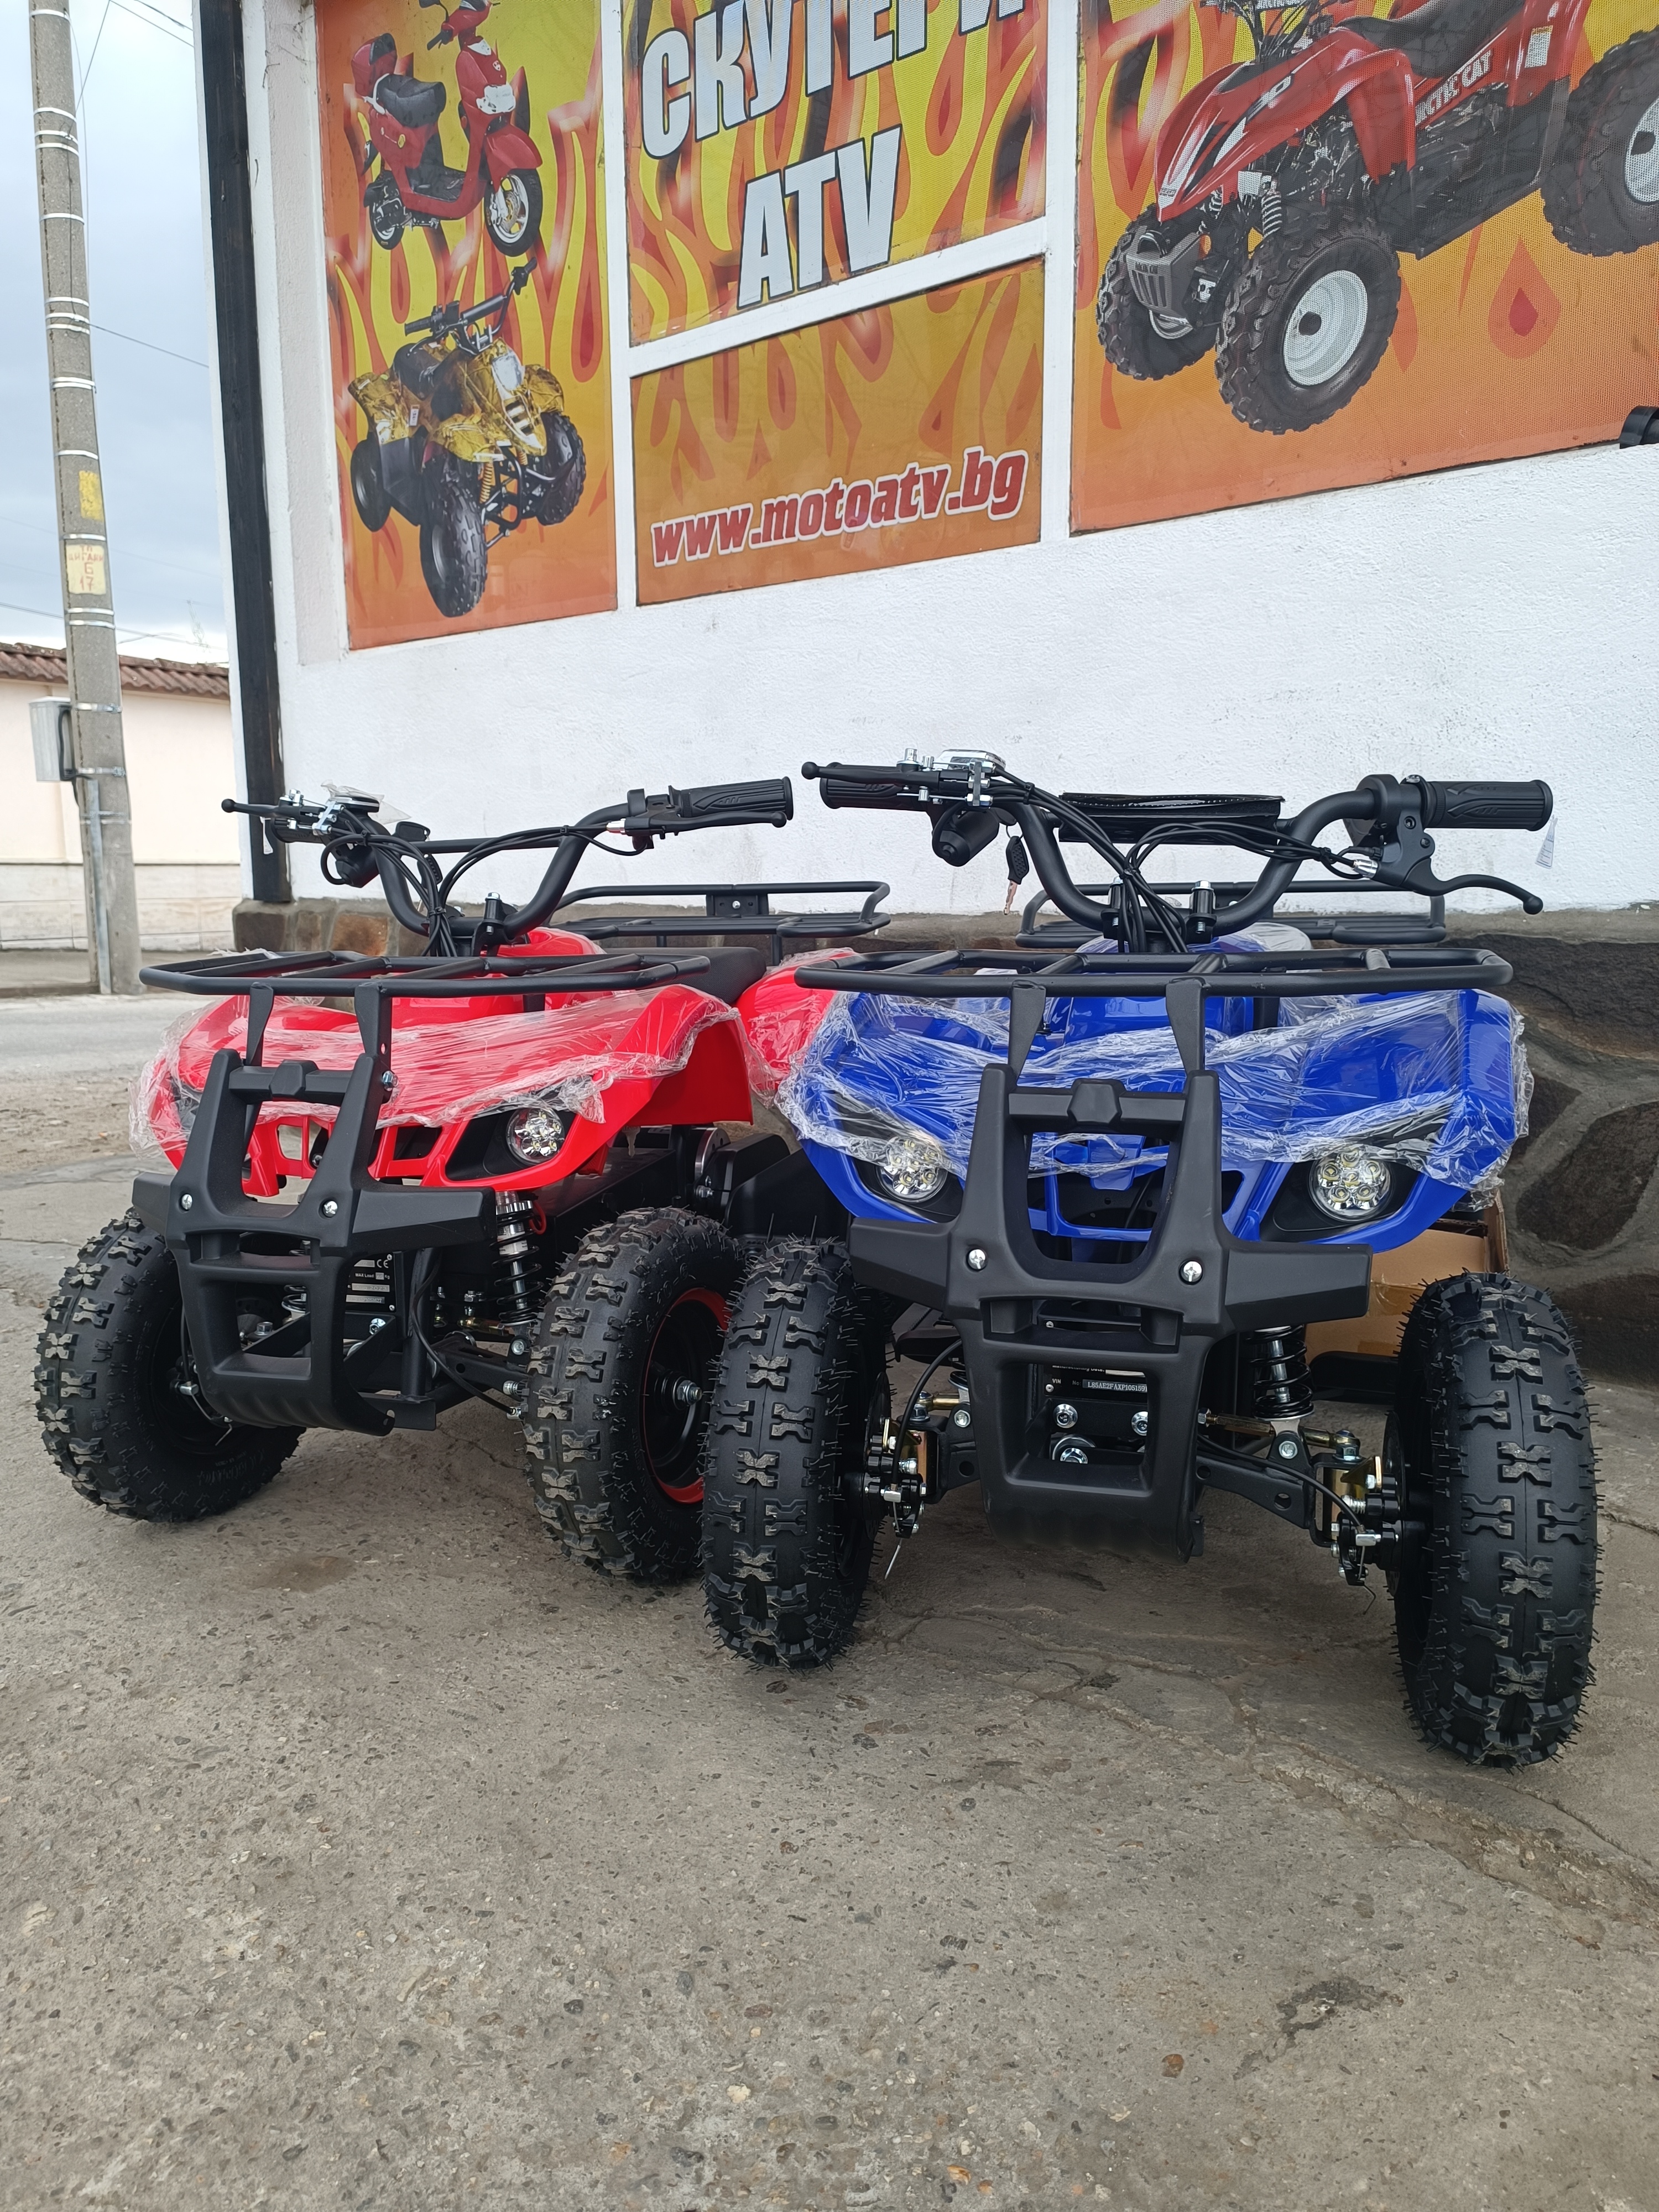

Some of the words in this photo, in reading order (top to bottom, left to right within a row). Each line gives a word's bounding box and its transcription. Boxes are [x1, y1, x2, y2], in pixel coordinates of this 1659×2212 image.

[641, 0, 1026, 159] СКУТЕ
[1462, 49, 1491, 87] CAT
[737, 124, 902, 310] ATV
[651, 446, 1029, 567] www.motoatv.bg
[80, 576, 93, 591] 17
